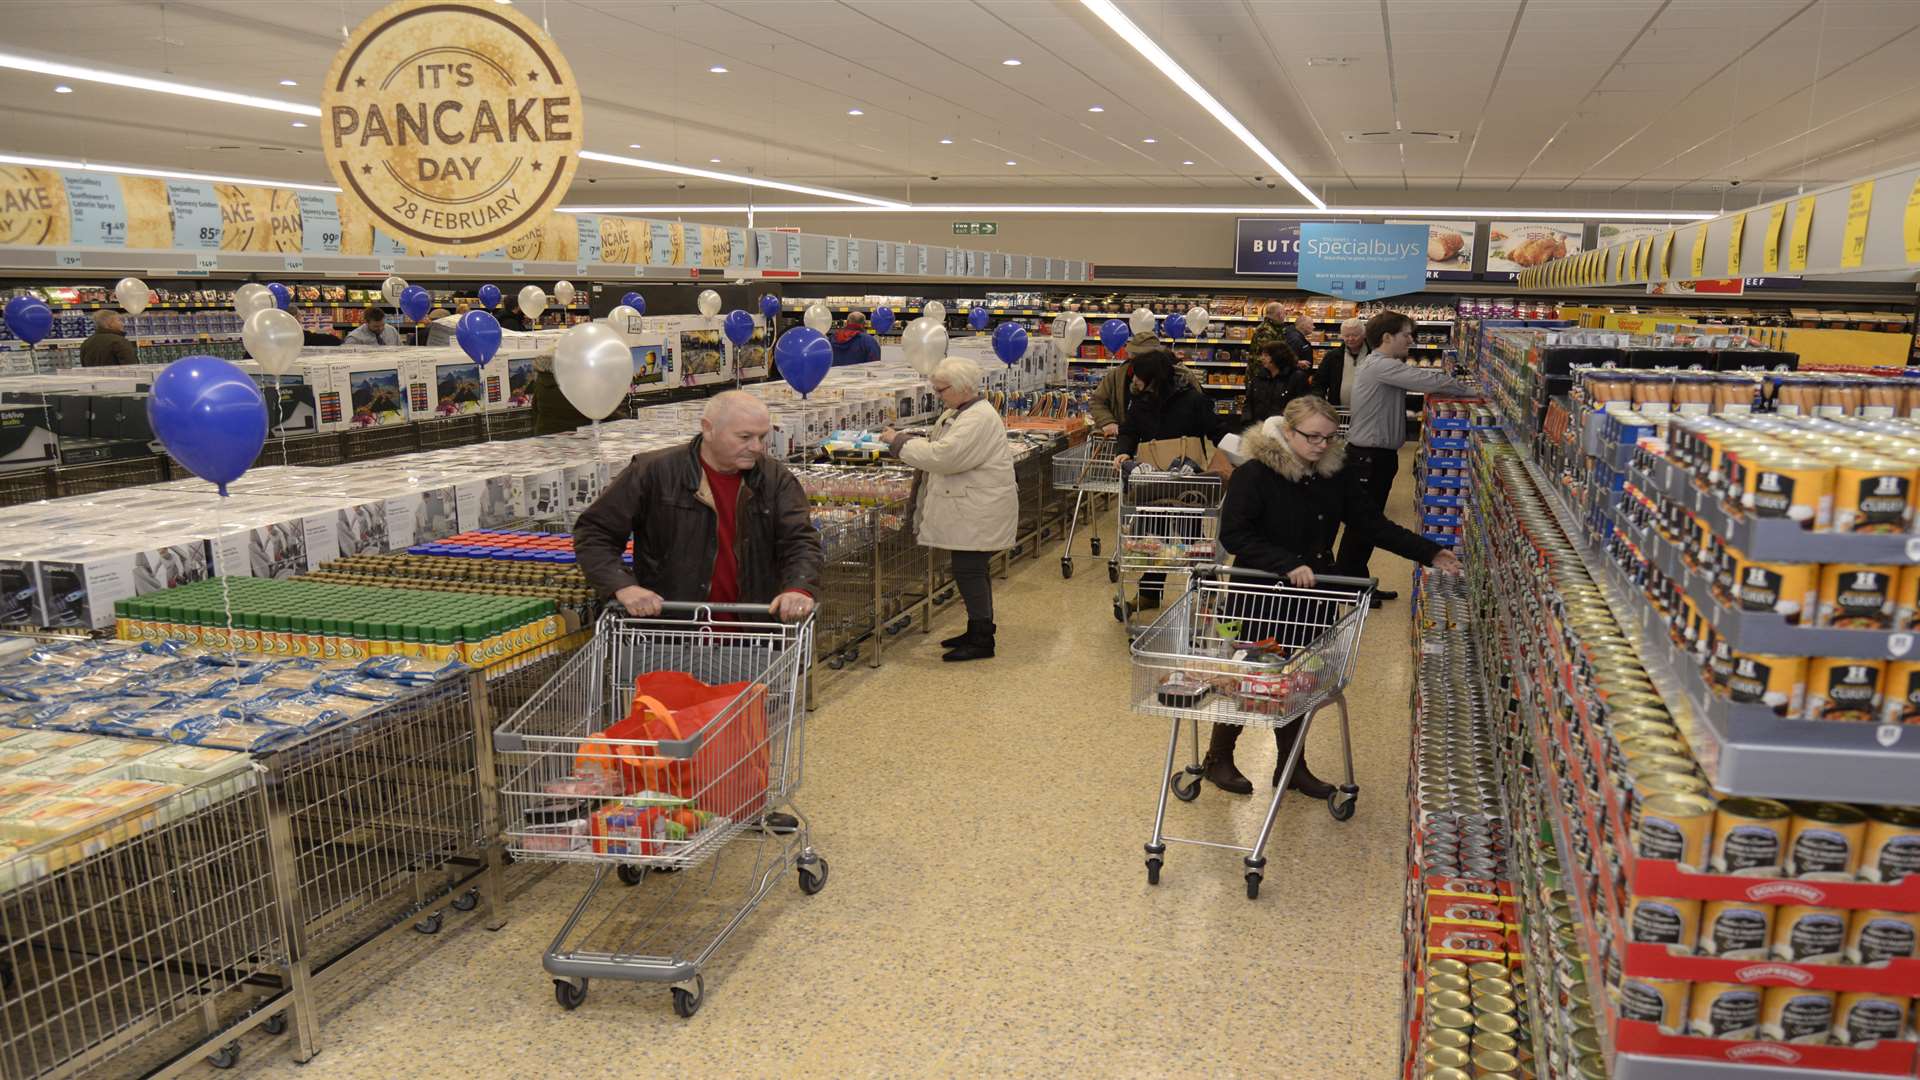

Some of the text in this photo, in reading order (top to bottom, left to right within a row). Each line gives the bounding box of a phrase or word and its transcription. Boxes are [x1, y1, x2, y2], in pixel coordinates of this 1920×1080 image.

[417, 63, 474, 89] IT'S
[332, 96, 572, 148] PANCAKE
[418, 157, 483, 182] DAY
[0, 187, 52, 213] AKE
[391, 188, 522, 230] 28 FEBRUARY
[101, 222, 126, 236] £1.49
[1307, 239, 1420, 260] Specialbuys
